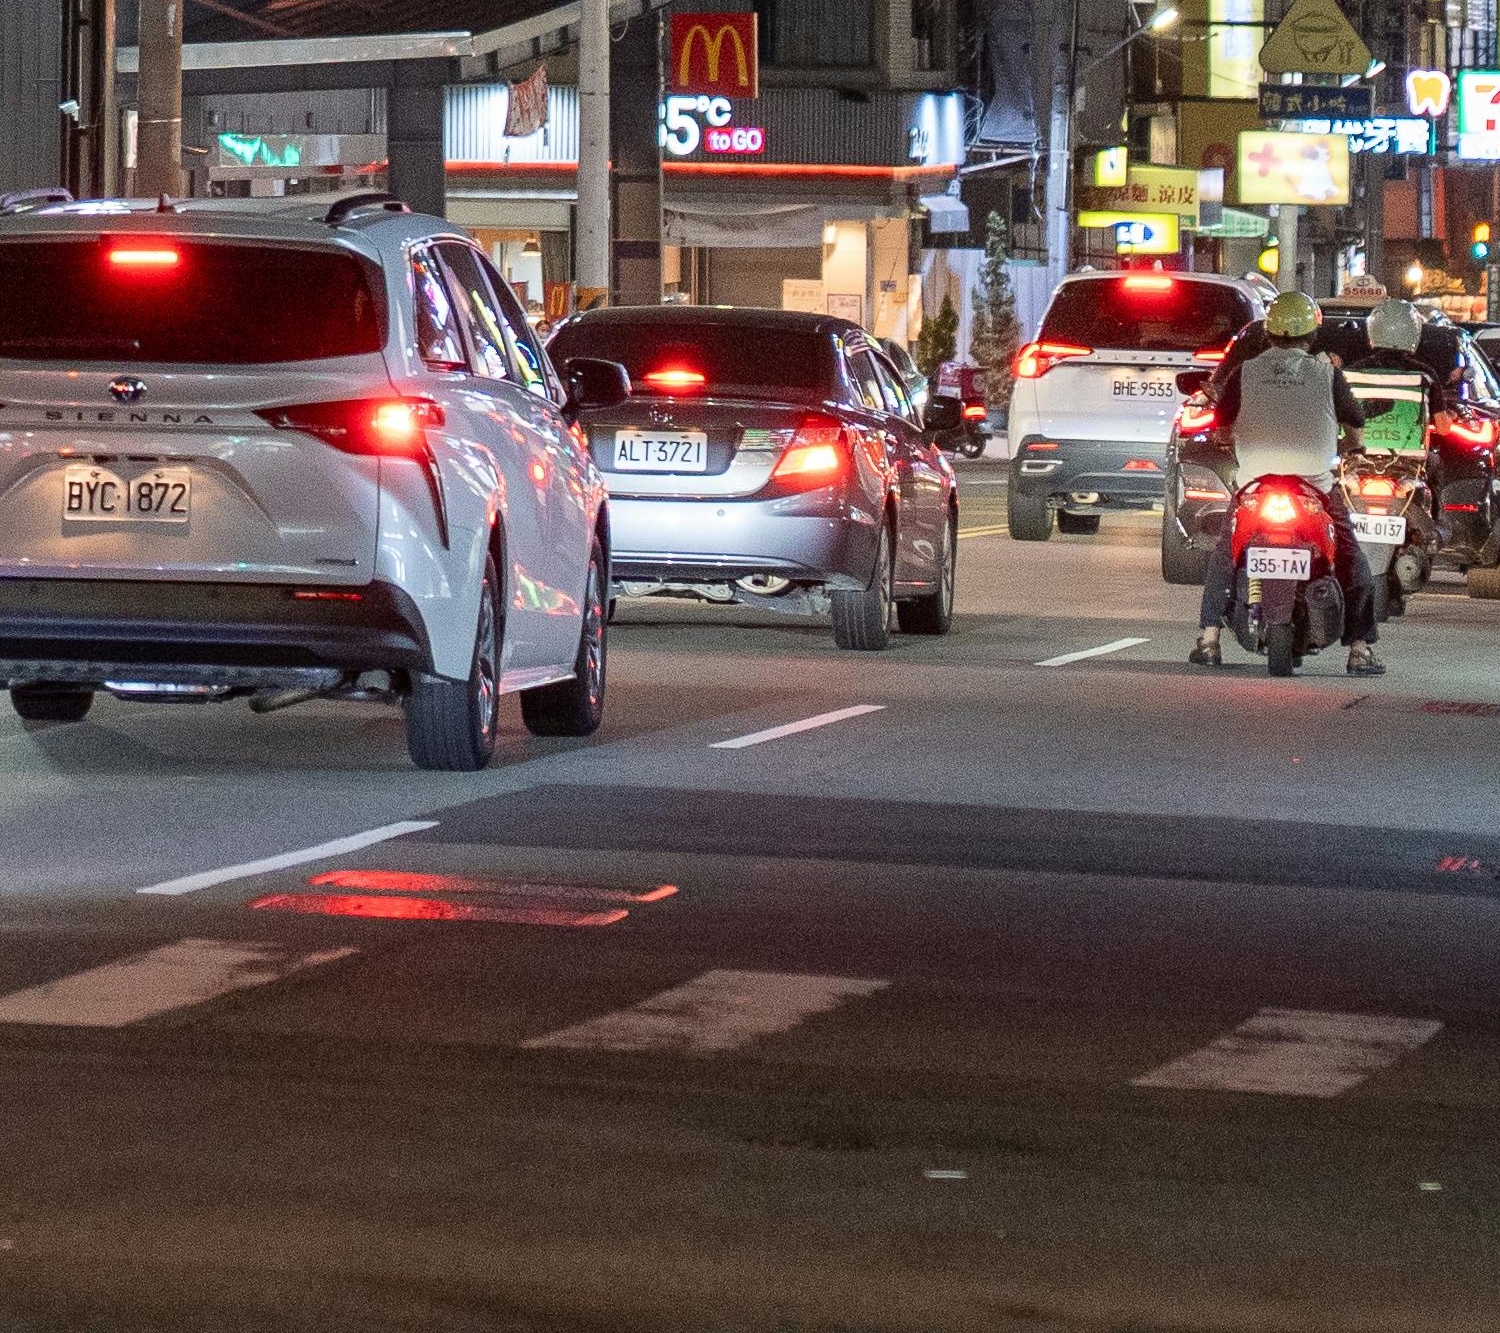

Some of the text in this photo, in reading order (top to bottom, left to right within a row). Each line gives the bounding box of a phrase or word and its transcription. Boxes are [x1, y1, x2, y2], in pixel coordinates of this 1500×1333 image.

[709, 130, 731, 150] to
[732, 130, 763, 151] GO
[46, 410, 215, 423] SIENNA
